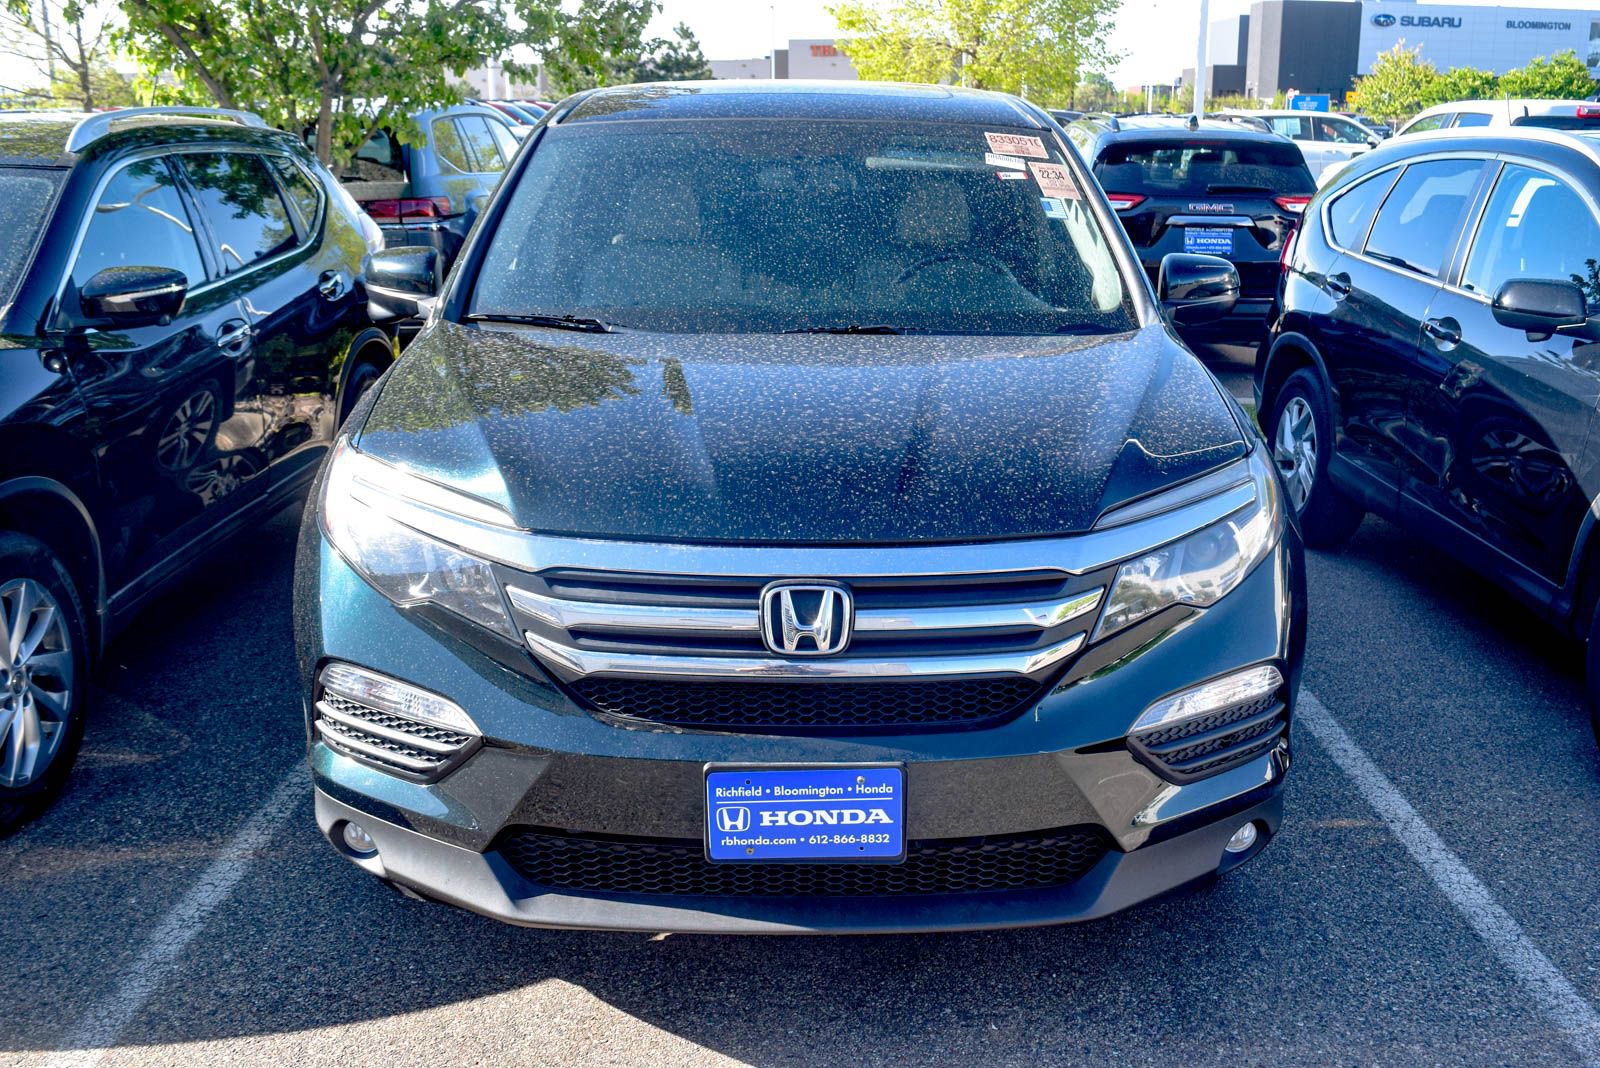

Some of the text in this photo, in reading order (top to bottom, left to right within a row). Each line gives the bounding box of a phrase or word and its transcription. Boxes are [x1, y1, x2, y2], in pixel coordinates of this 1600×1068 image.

[1400, 16, 1462, 28] SUBARU
[1506, 20, 1571, 30] BLOOMINGTON
[1189, 203, 1234, 214] GMC
[715, 783, 893, 798] Richfield Bloomington Honda
[759, 808, 894, 827] HONDA
[721, 834, 890, 846] rbhonda.com 612-866-8832
